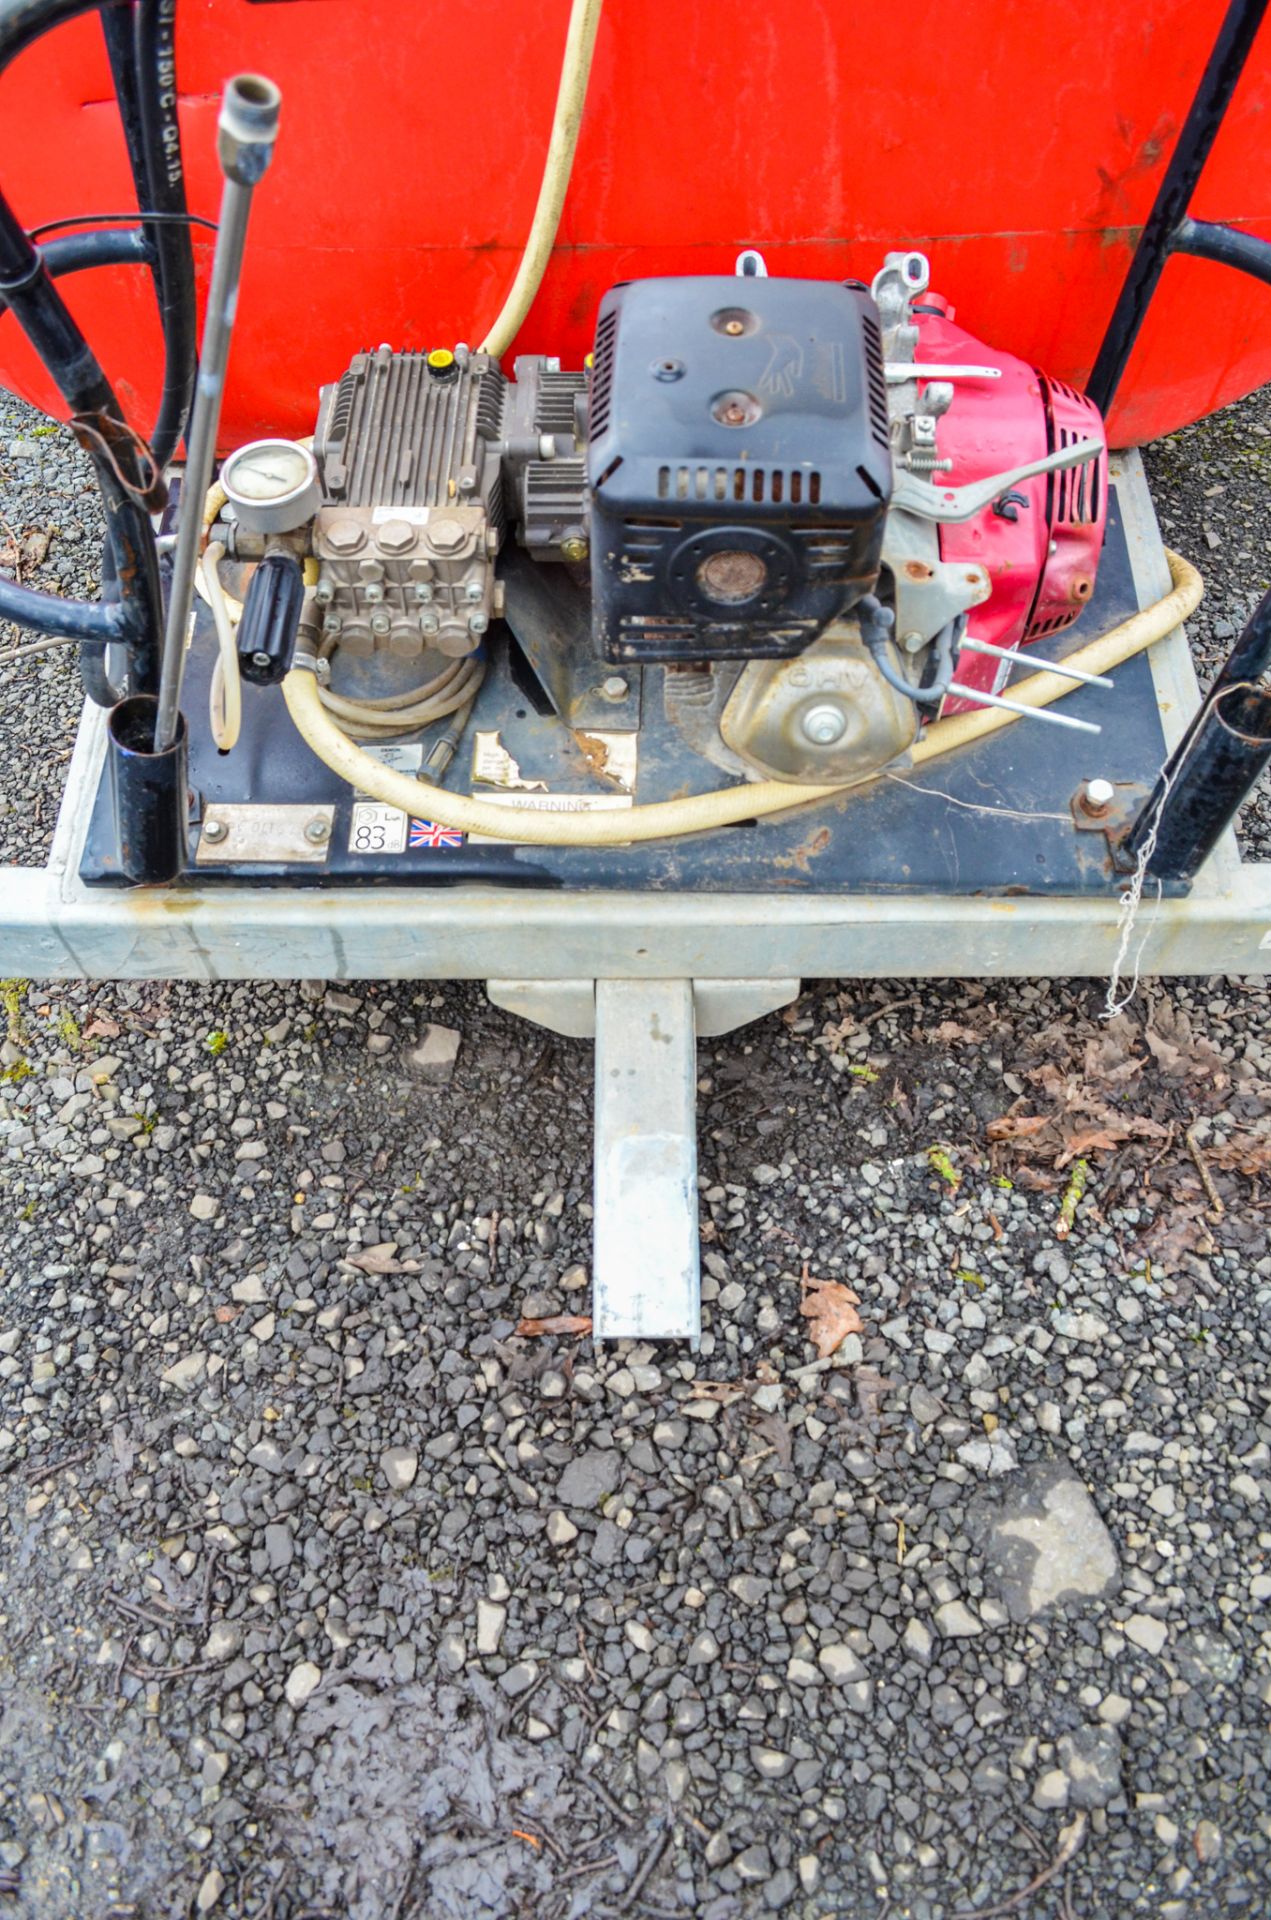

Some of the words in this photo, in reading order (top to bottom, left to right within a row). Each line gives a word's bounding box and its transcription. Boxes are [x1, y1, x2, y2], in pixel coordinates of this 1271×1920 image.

[787, 666, 868, 689] OHV
[512, 799, 592, 812] WARNING
[355, 825, 385, 850] 83
